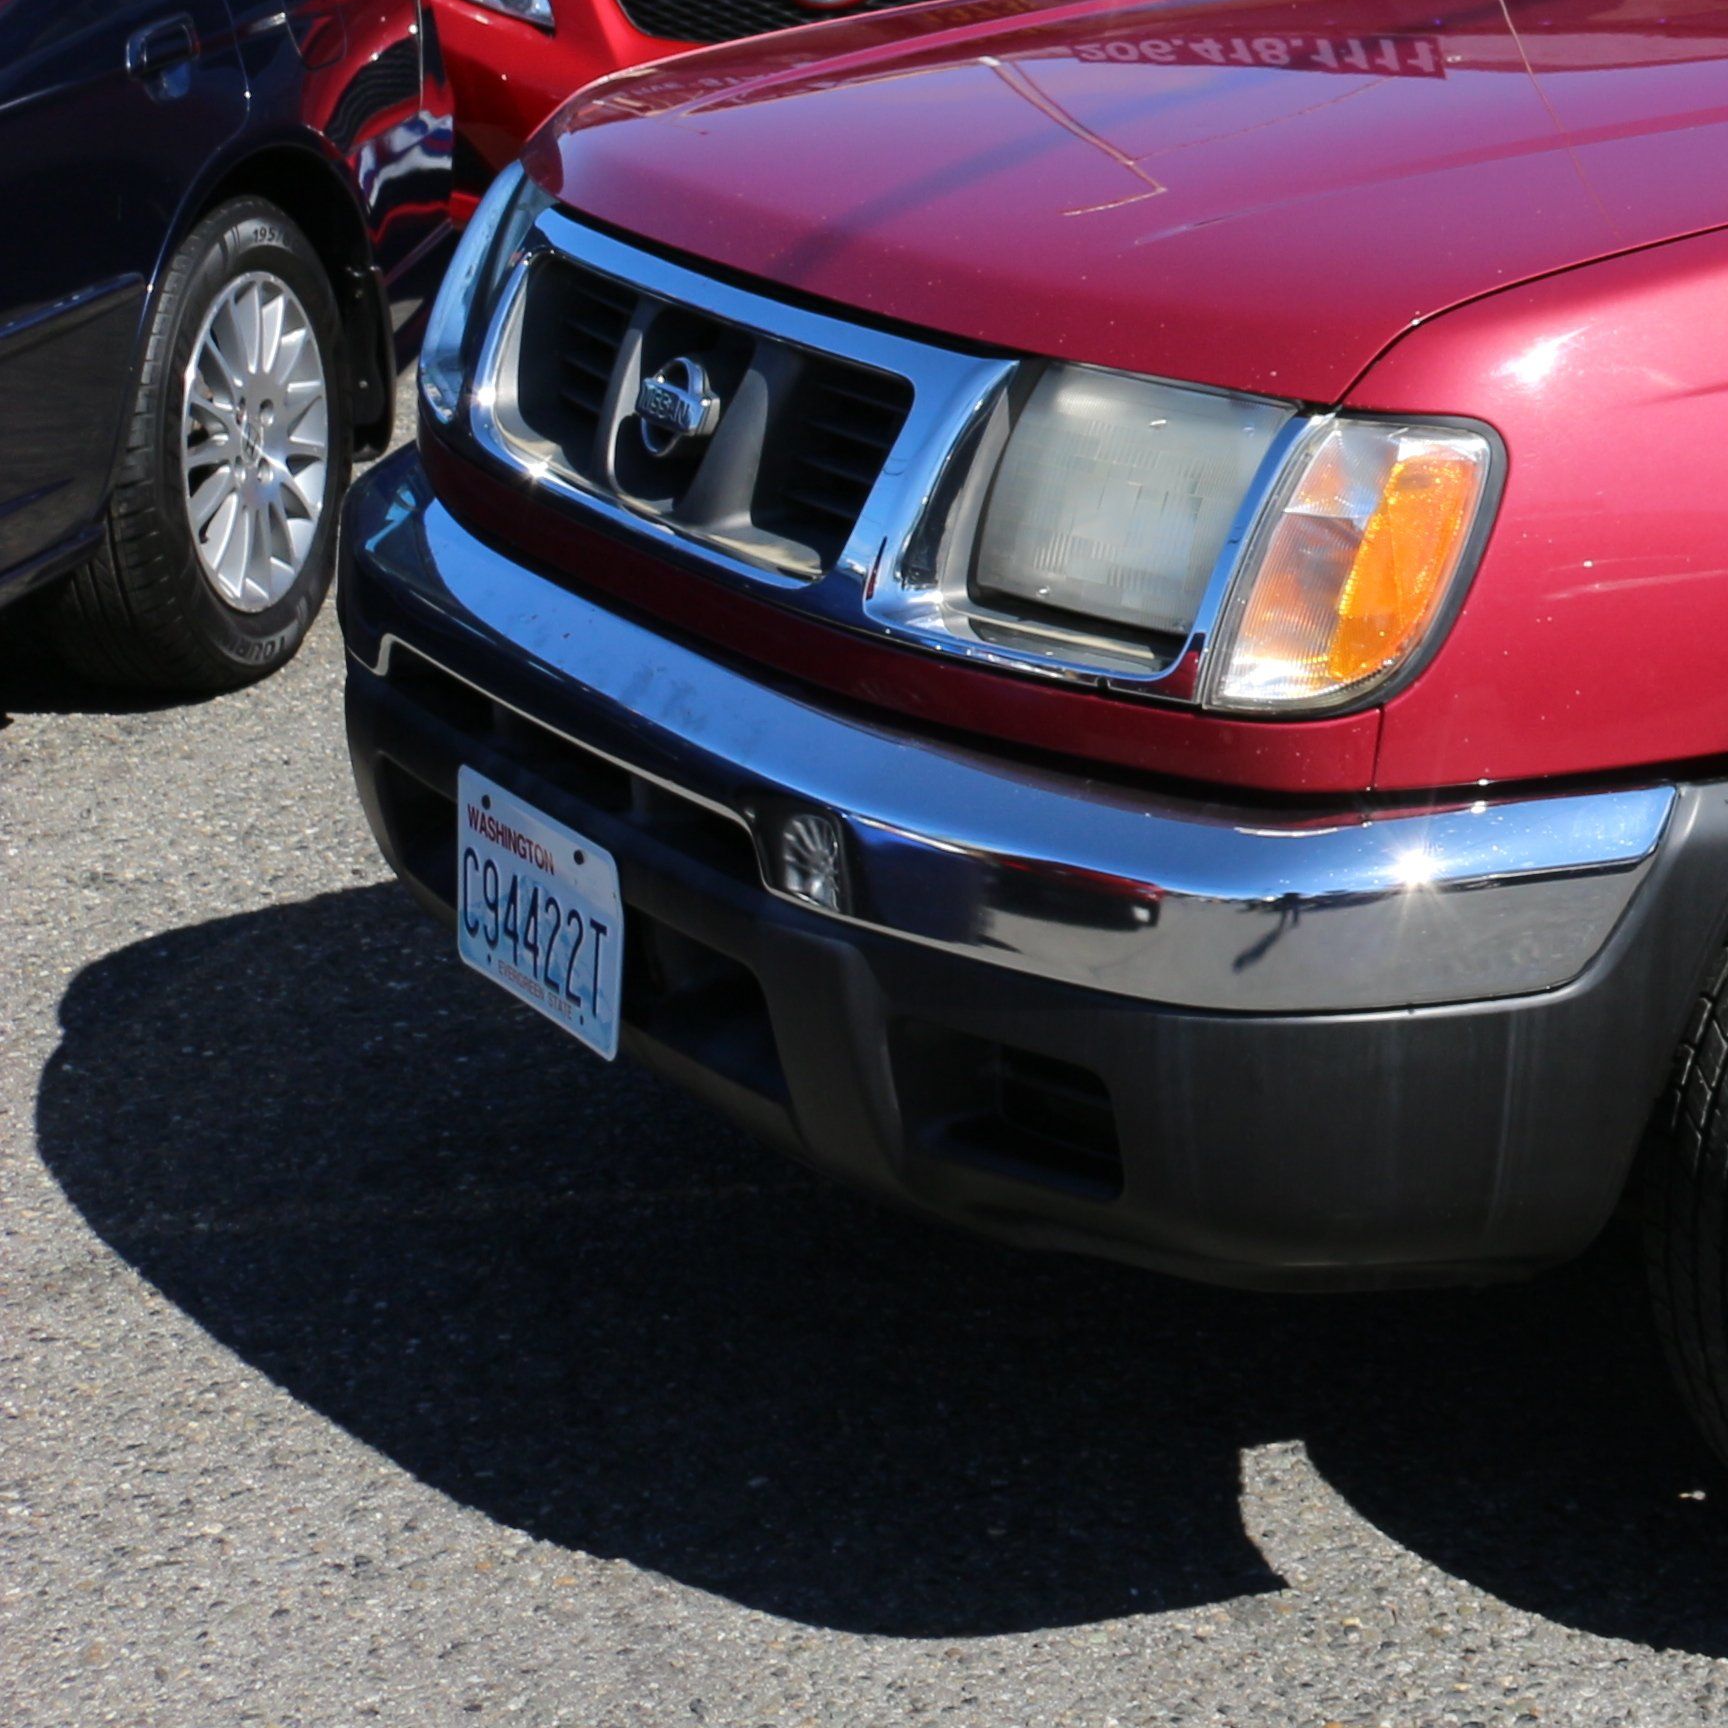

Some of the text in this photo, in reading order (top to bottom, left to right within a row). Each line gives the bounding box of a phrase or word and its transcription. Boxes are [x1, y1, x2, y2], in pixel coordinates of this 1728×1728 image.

[637, 384, 690, 426] NISSAN
[466, 802, 556, 877] WASHINGTON
[461, 845, 608, 1020] C94422T
[496, 958, 573, 1022] EVERGREEN STATE
